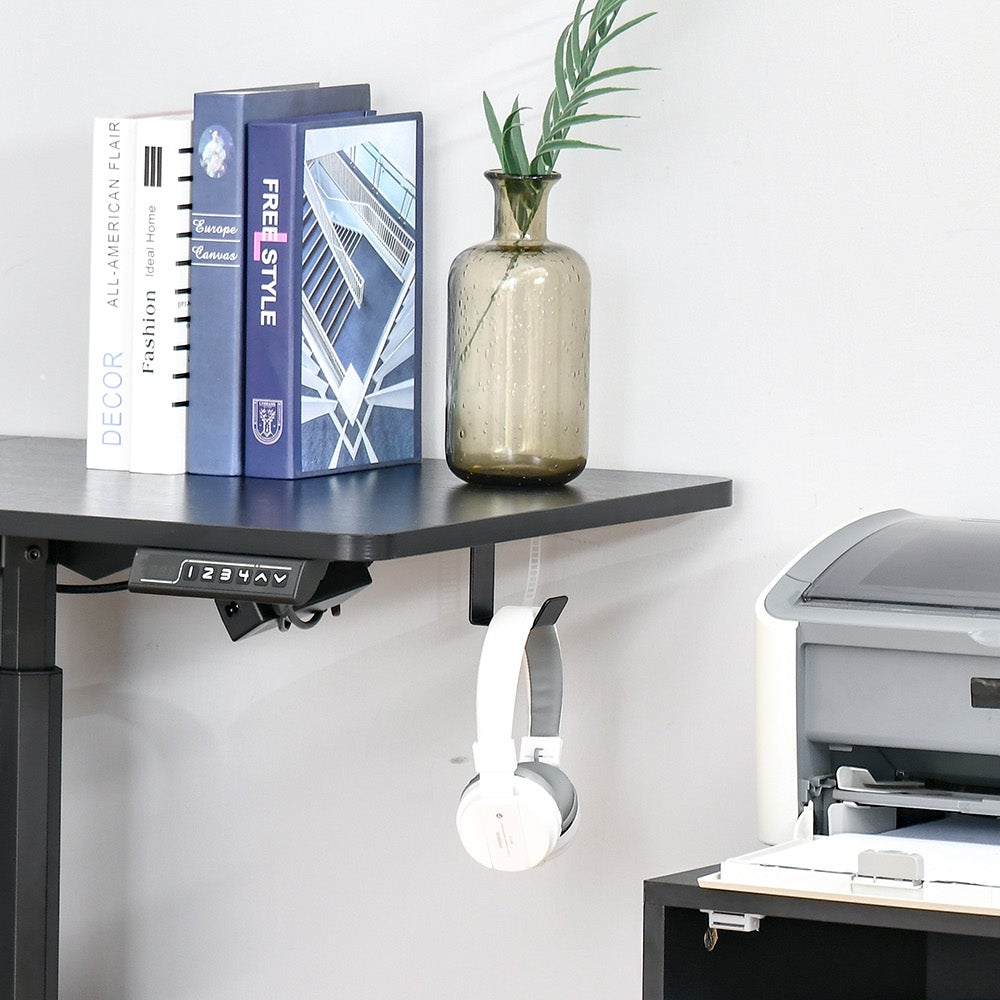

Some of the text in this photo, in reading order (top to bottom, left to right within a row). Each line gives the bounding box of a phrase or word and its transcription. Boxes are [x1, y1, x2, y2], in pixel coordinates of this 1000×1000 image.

[107, 121, 121, 308] ALL-AMERICAN FLAIR
[145, 205, 157, 277] Ideal Home
[191, 245, 239, 261] Canvas
[192, 218, 239, 238] Europe
[260, 178, 279, 326] FREE STYLE
[142, 290, 156, 374] Fashion
[101, 352, 123, 446] DECOR
